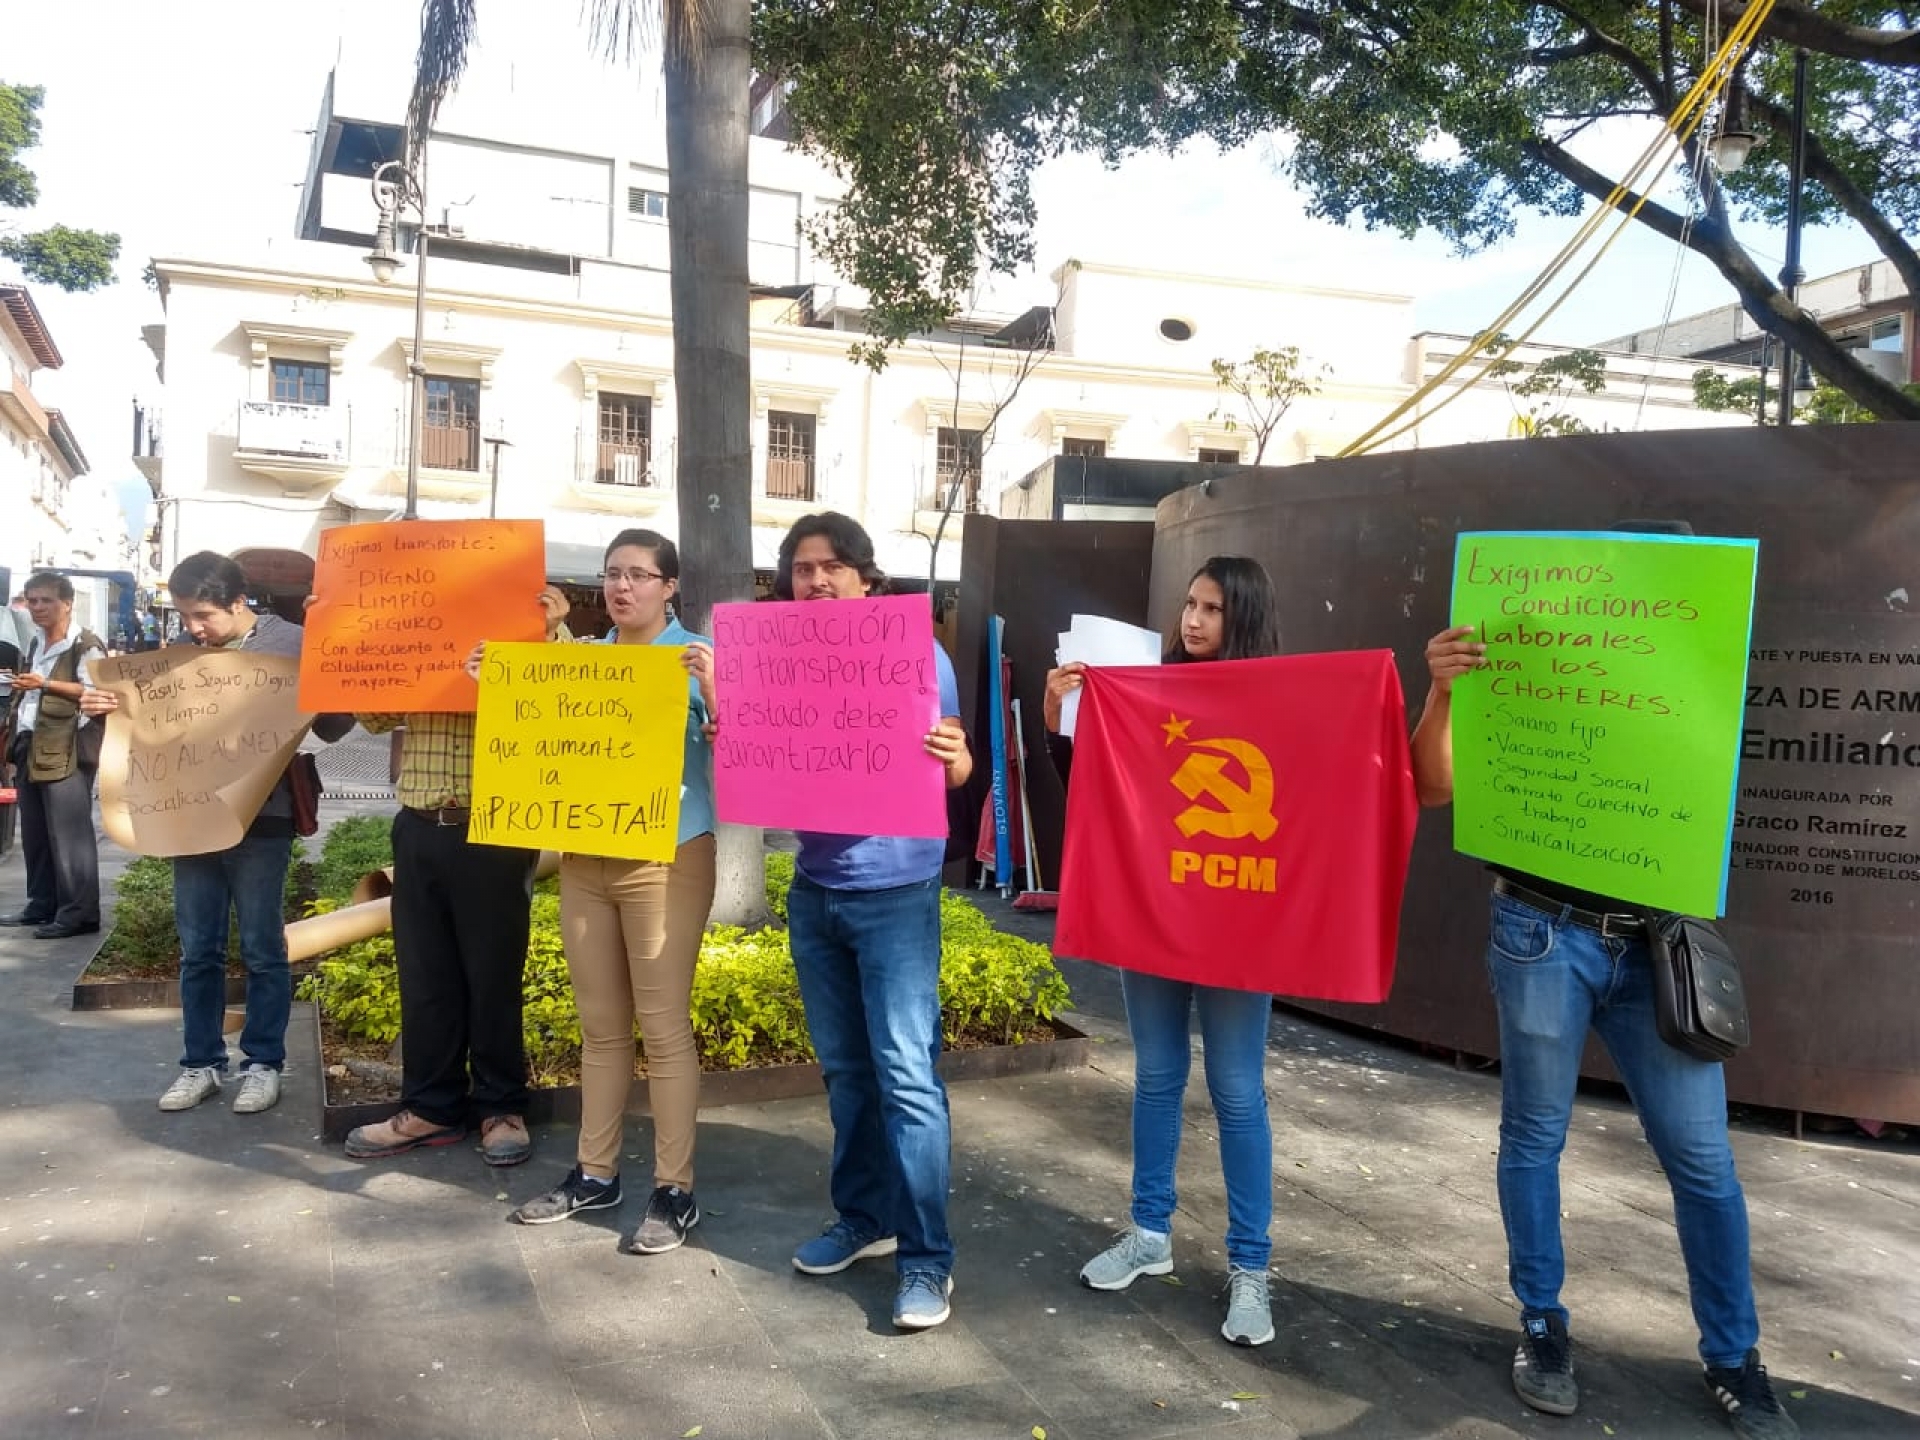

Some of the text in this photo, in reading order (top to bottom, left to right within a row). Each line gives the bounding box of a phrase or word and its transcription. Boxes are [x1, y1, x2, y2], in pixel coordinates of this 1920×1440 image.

[322, 535, 496, 568] Exigimos transporte:
[1468, 547, 1614, 594] Exigimos
[355, 640, 432, 656] descuento
[443, 642, 456, 652] a
[1784, 650, 1795, 661] Y
[1800, 651, 1862, 664] PUESTA
[1869, 652, 1890, 664] EN
[118, 659, 169, 679] Por un
[320, 659, 407, 673] estudiantes
[486, 651, 635, 684] Si aumentan
[756, 650, 927, 695] transporte!
[1464, 658, 1608, 676] ara los
[135, 667, 294, 703] Pasaje Seguro, Digno
[1490, 677, 1683, 716] CHOFERES:
[515, 699, 541, 721] los
[1800, 688, 1841, 710] DE
[1851, 690, 1920, 712] ARM
[151, 703, 219, 729] y Limpio
[737, 696, 819, 728] estado
[833, 696, 898, 730] debe
[489, 738, 635, 762] que aumente
[718, 735, 891, 774] garantizarlo
[539, 768, 561, 785] la
[1497, 757, 1650, 794] Seguridad Social
[1493, 775, 1692, 823] Contrato Colectivo de
[1743, 788, 1893, 806] INAUGURADA POR
[1520, 801, 1587, 830] trabajo
[1807, 815, 1907, 838] Ramírez
[1170, 850, 1276, 892] PCM
[1746, 858, 1809, 873] ESTADO
[1815, 863, 1835, 875] DE
[1842, 866, 1920, 881] MORELOS
[1790, 888, 1834, 904] 2016
